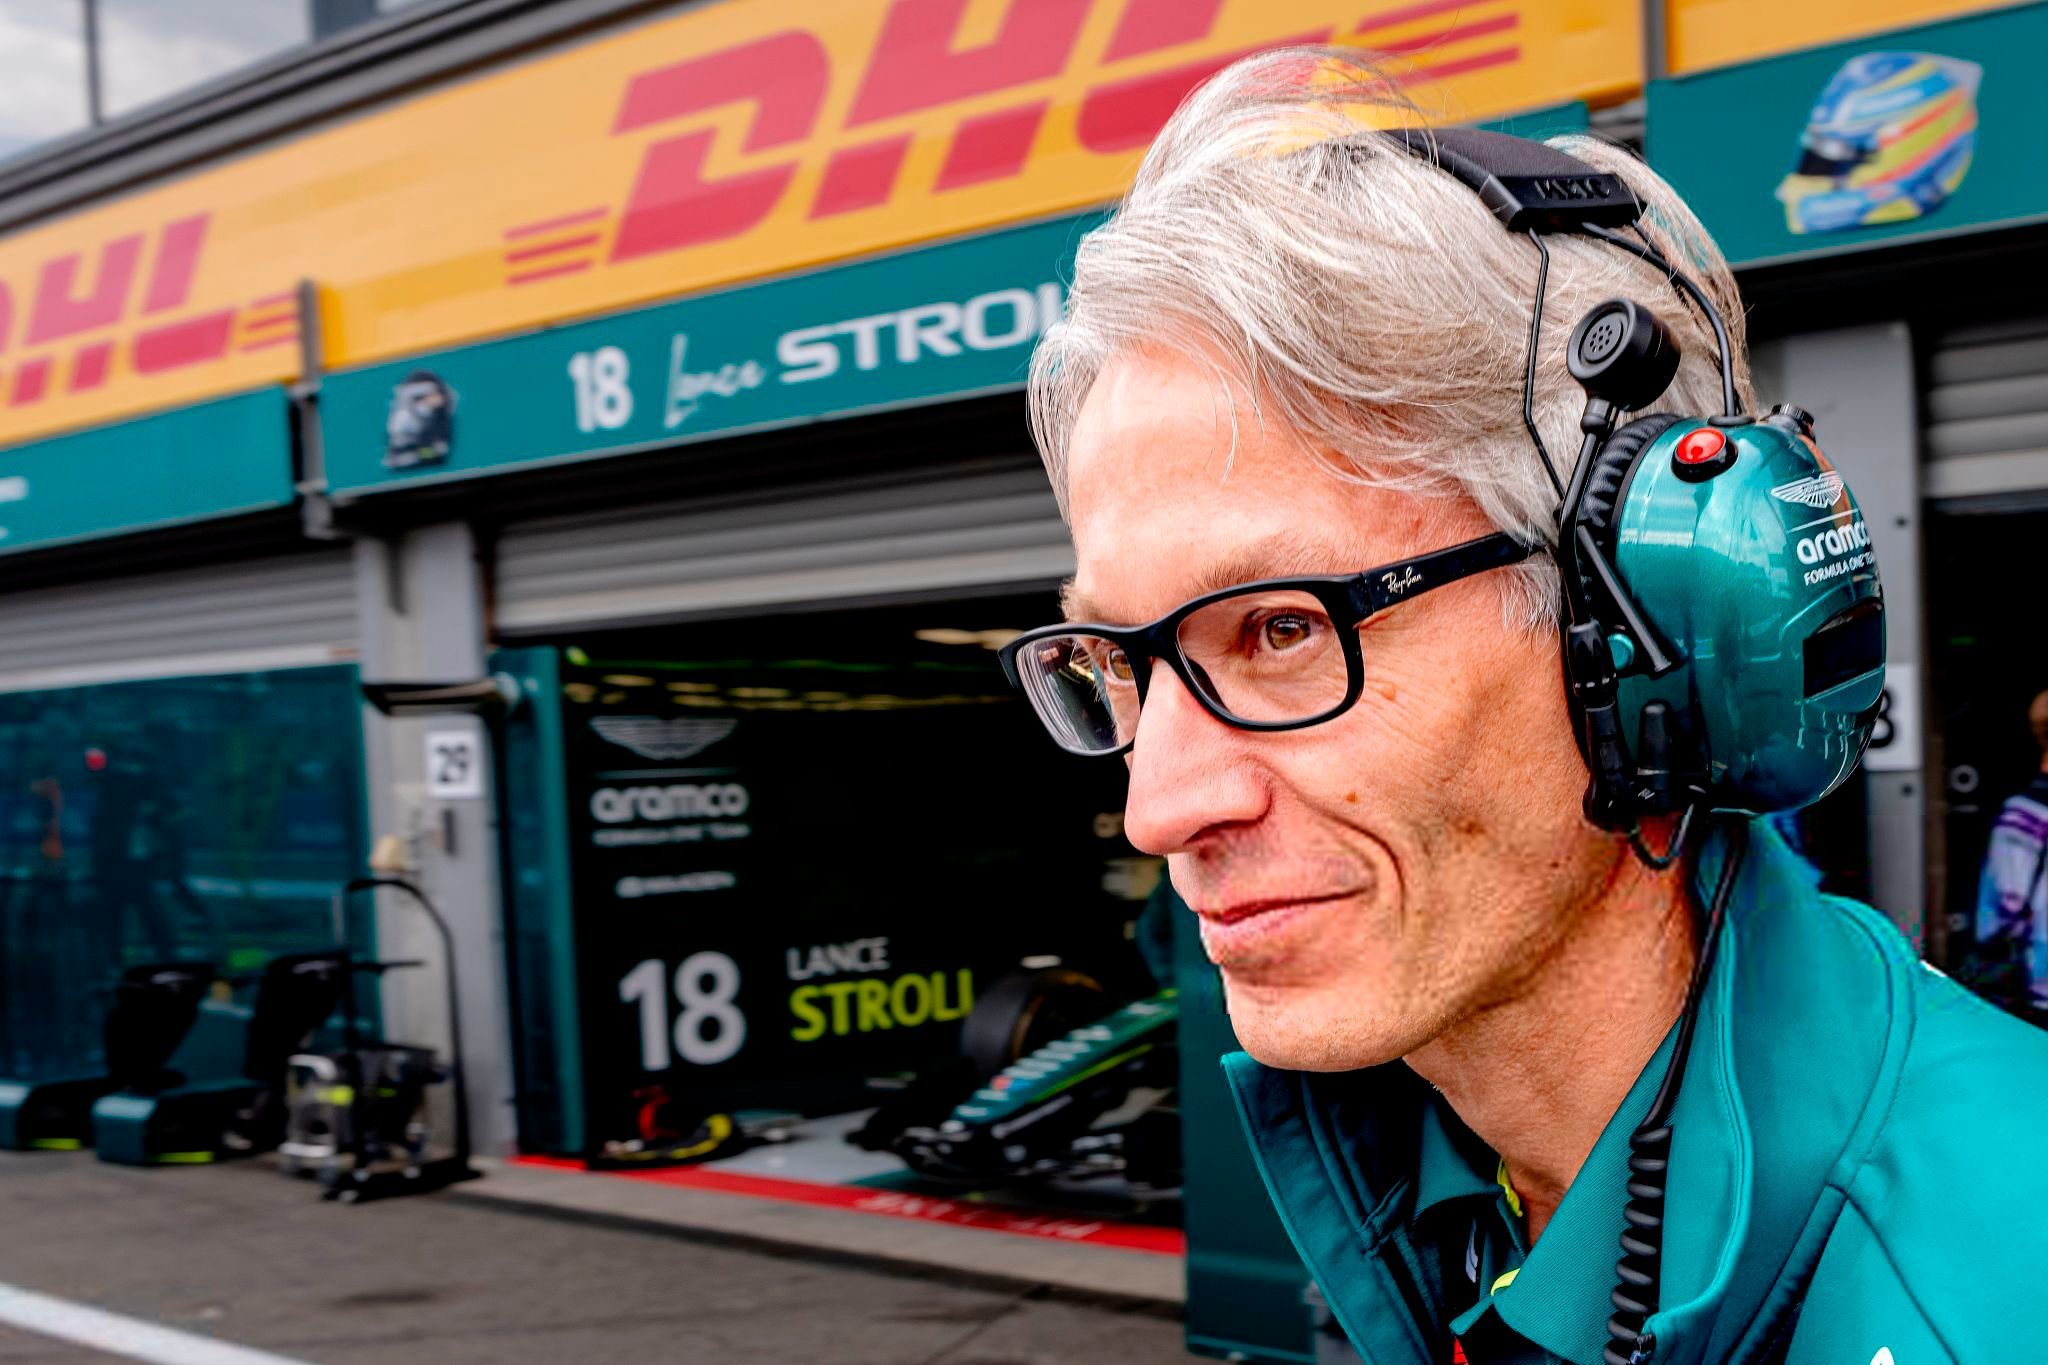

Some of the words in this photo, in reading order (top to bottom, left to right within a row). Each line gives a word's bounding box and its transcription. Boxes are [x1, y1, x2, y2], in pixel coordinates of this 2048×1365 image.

[606, 0, 1338, 266] DHL
[0, 211, 238, 408] HL
[567, 345, 633, 433] 18
[776, 283, 1063, 384] STROL
[1803, 559, 1849, 586] FORMULA
[436, 744, 469, 784] 29
[590, 783, 749, 824] aramco
[786, 936, 890, 981] LANCE
[619, 951, 747, 1071] 18
